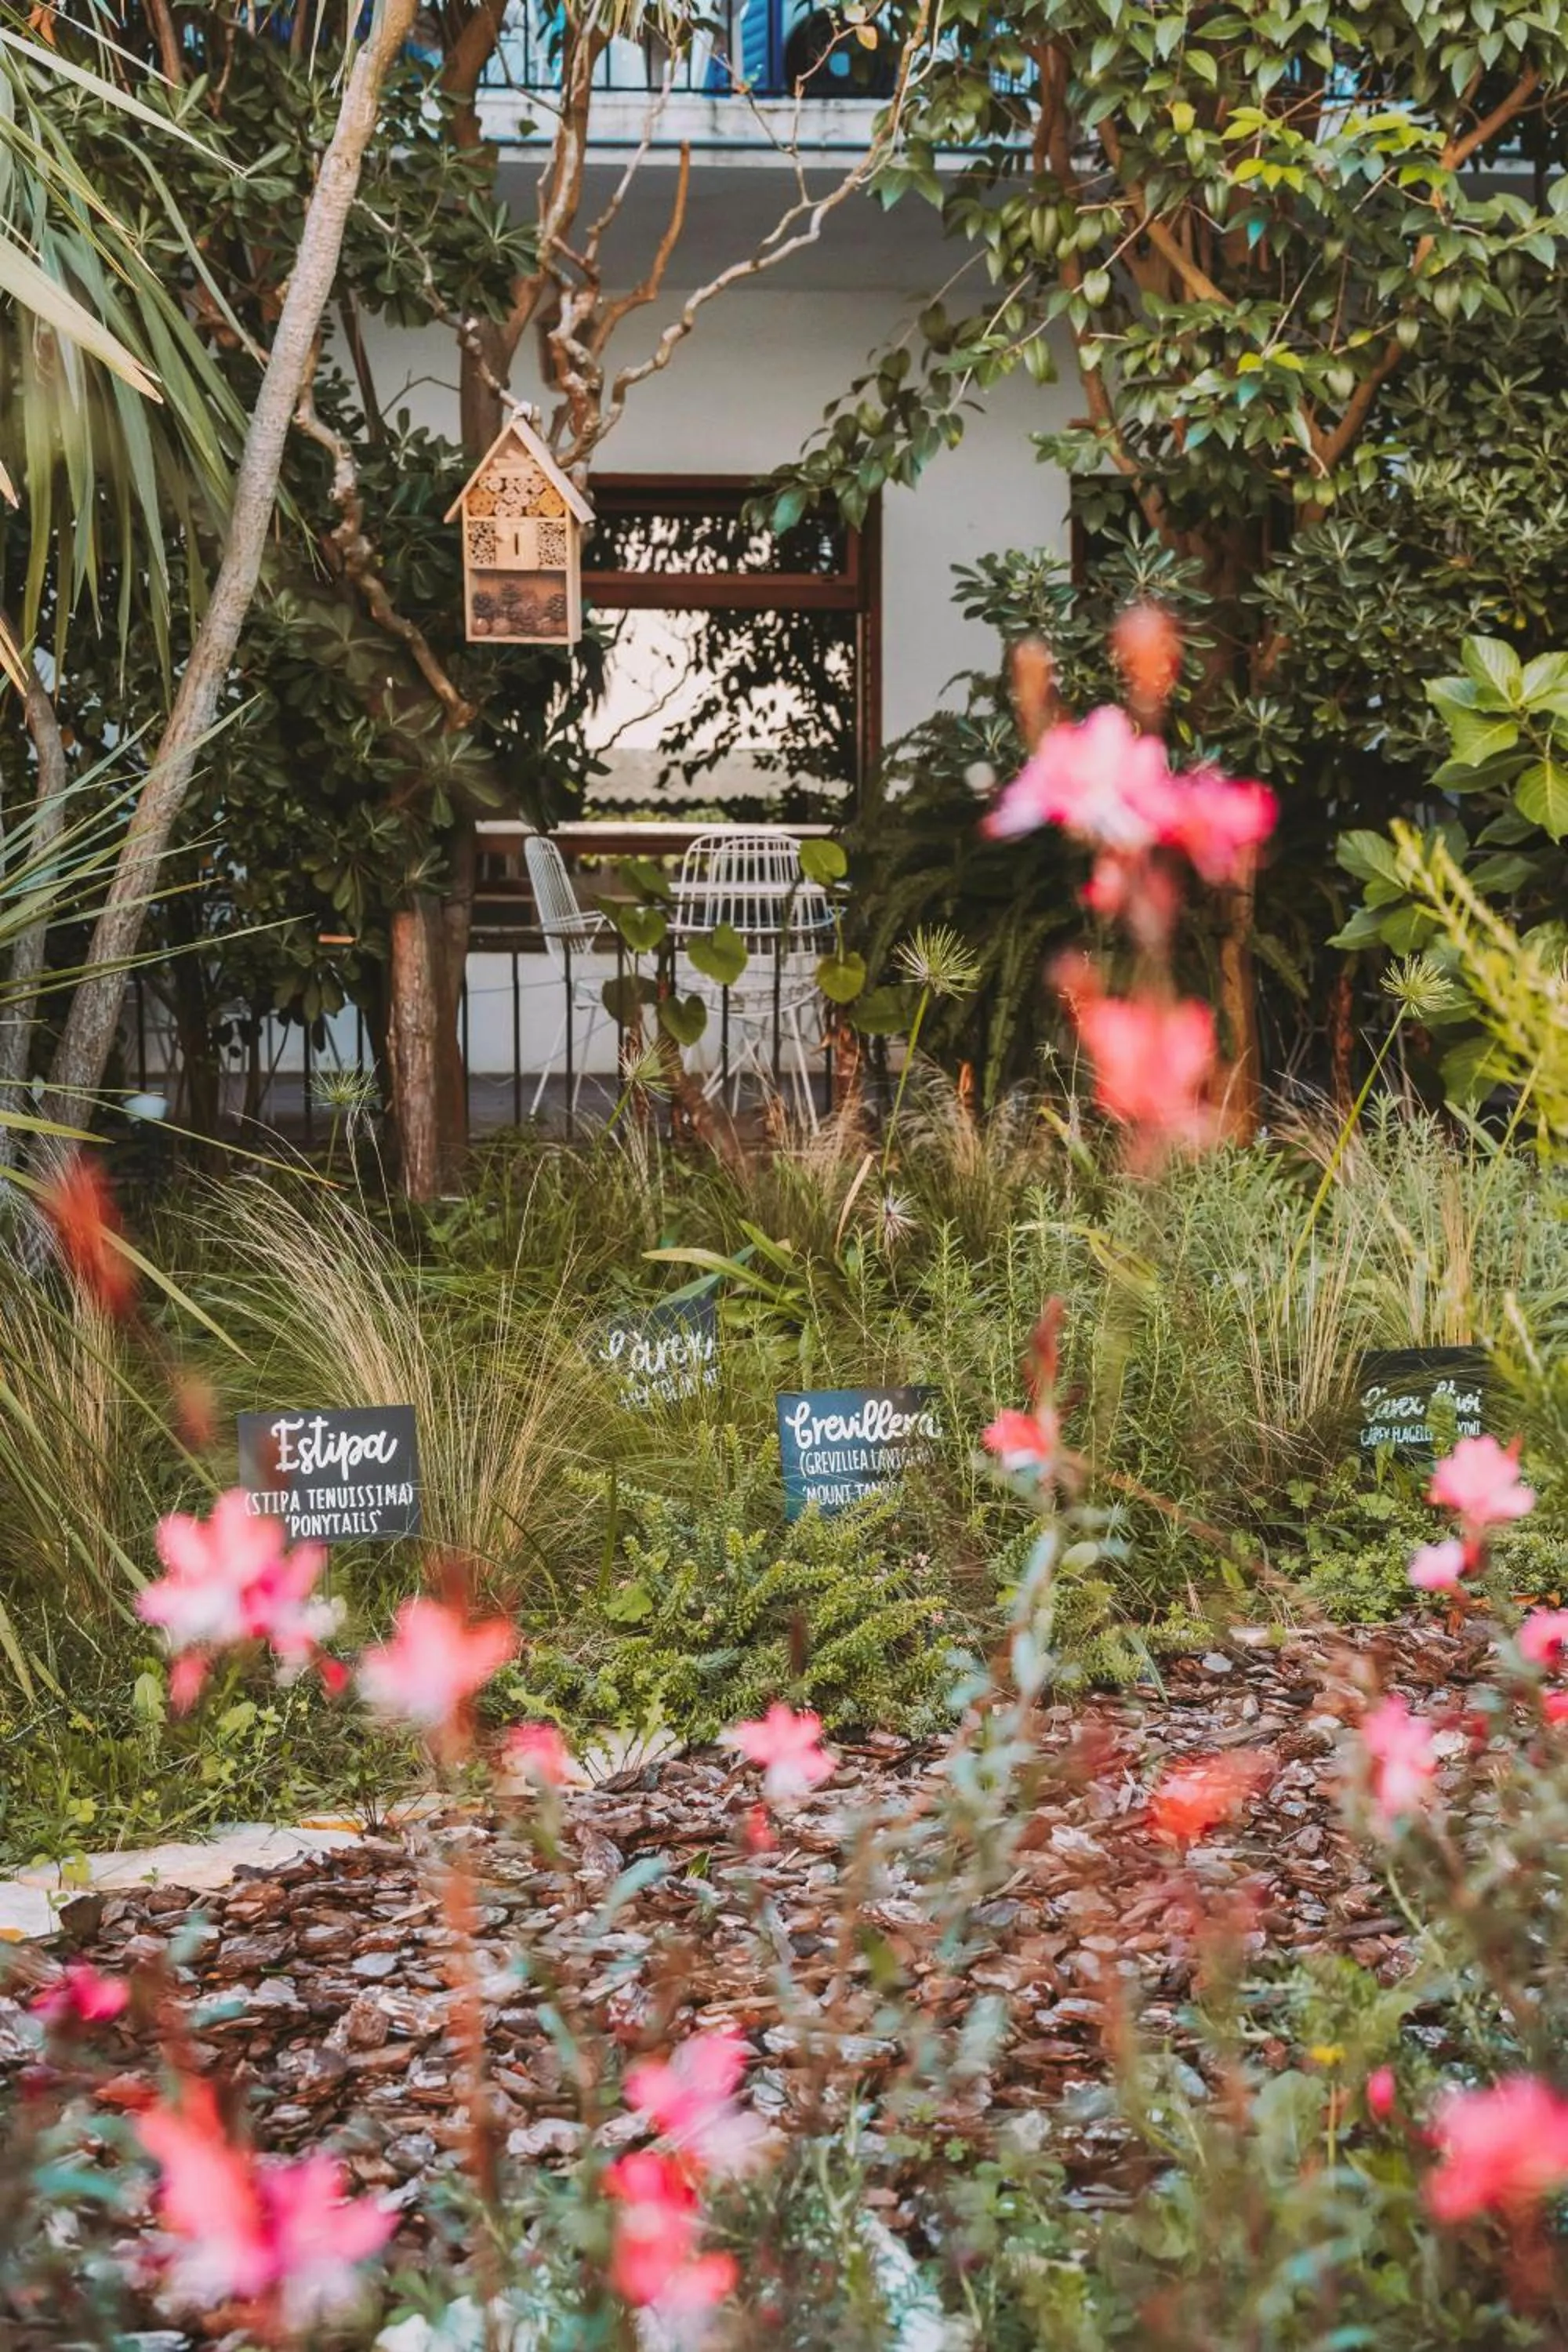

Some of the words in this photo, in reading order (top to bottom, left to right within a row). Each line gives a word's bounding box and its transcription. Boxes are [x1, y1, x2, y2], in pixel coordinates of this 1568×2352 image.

[270, 1414, 398, 1481] Estipa
[800, 1449, 869, 1478] (GREVILLEA
[244, 1490, 301, 1516] (STIPA
[307, 1482, 414, 1510] TENUISSIMA)
